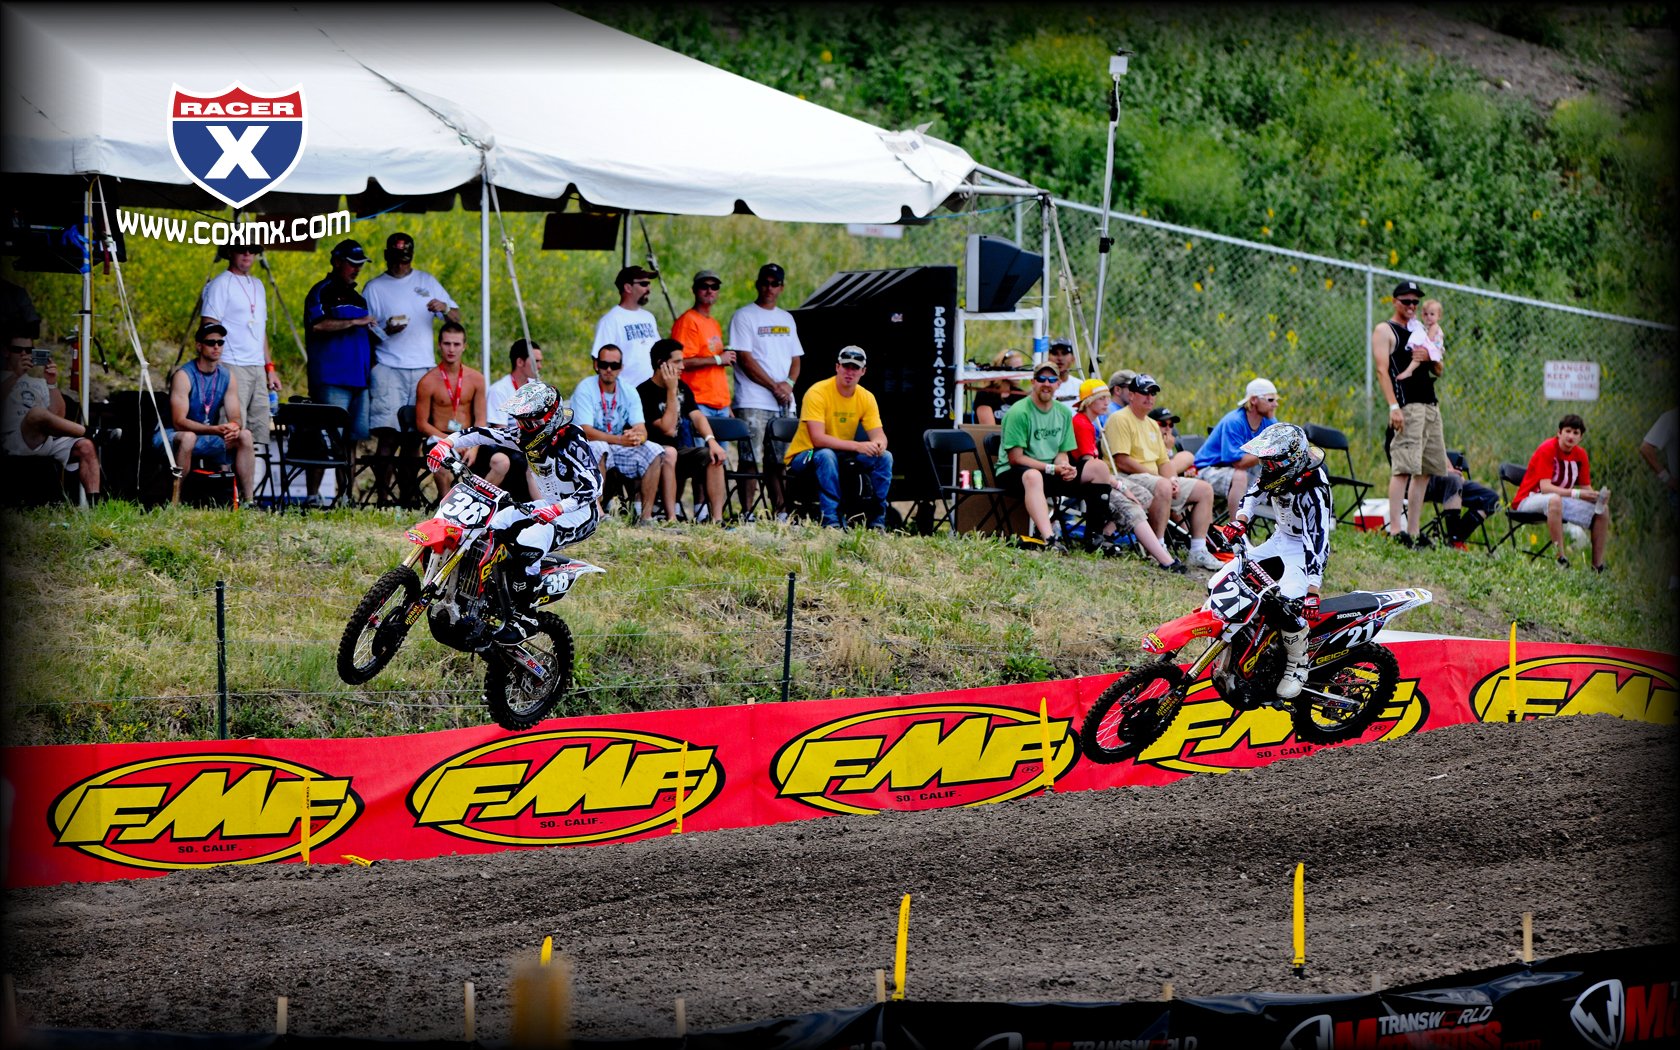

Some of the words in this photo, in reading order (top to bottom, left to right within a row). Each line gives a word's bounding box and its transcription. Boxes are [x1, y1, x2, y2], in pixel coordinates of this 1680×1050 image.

[1553, 363, 1591, 372] DANGER
[1577, 372, 1595, 382] OUT
[525, 433, 545, 450] GEICO
[441, 492, 491, 526] 38
[547, 572, 569, 595] 38
[1211, 581, 1253, 618] 21
[1336, 611, 1362, 620] HONDA
[1346, 620, 1375, 648] 21
[1316, 648, 1350, 666] GEICO
[775, 714, 1074, 799] FMF
[1256, 750, 1277, 759] SO.
[414, 741, 718, 827] FMF
[896, 793, 916, 802] SO.
[919, 790, 962, 801] CALIF.
[53, 766, 353, 846] FMF
[539, 820, 561, 828] SO.
[564, 817, 604, 827] CALIF.
[178, 845, 199, 854] SO.
[203, 843, 243, 853] CALIF.
